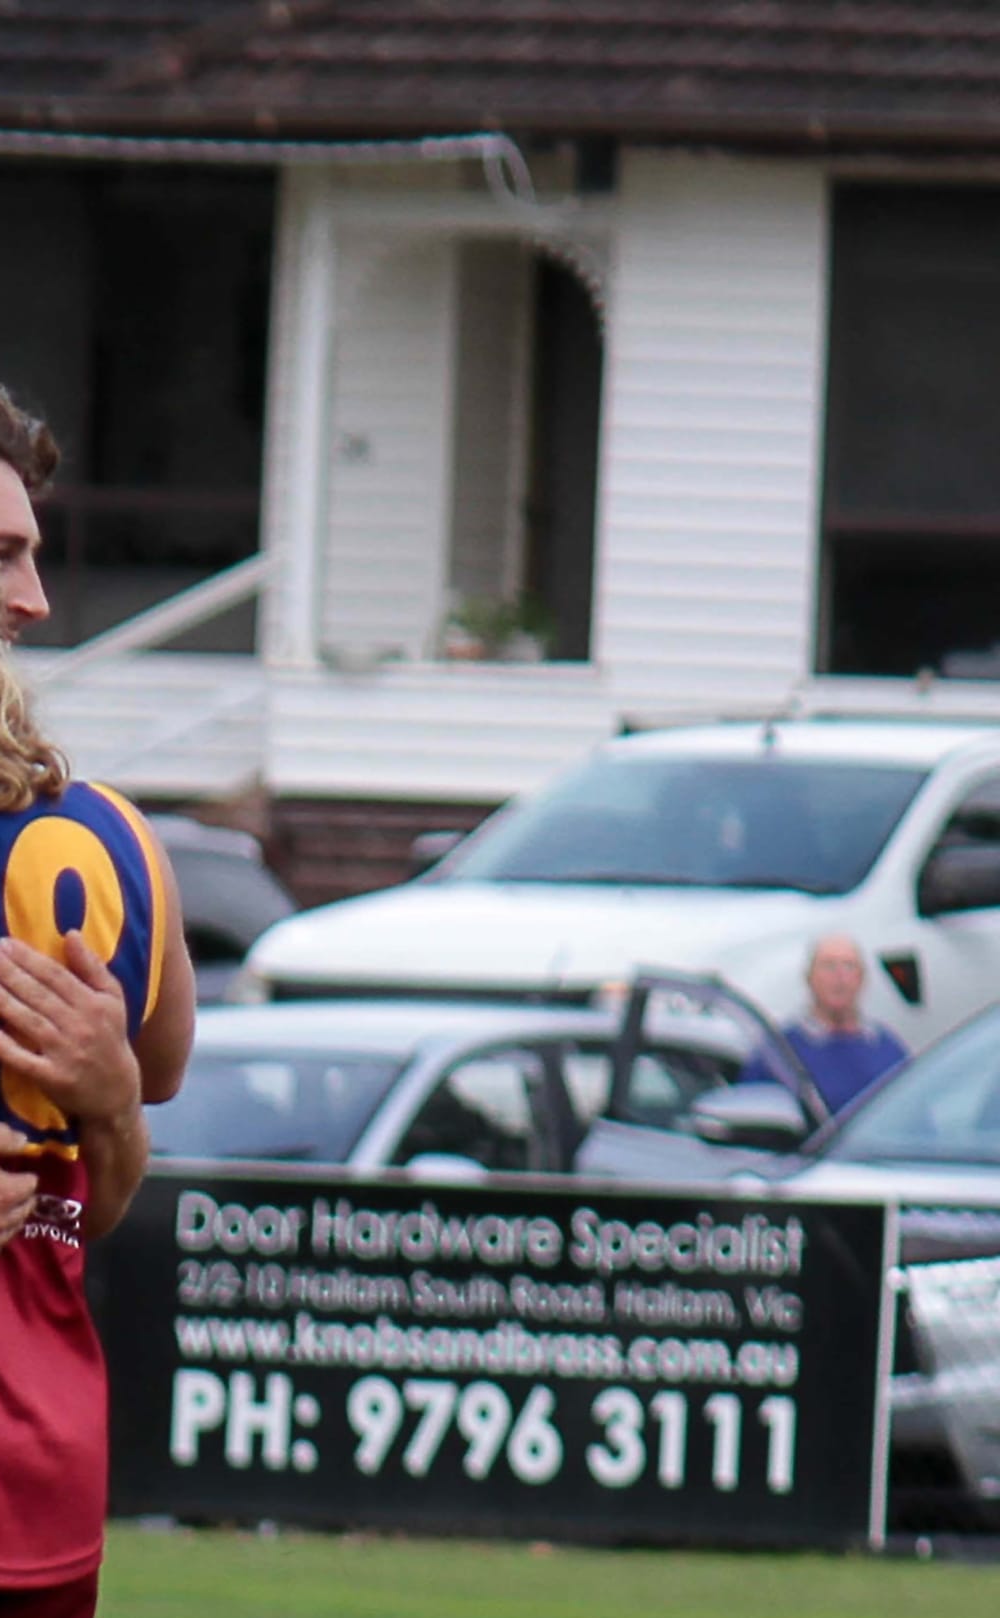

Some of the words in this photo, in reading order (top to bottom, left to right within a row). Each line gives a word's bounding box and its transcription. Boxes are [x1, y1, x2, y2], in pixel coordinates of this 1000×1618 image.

[177, 1190, 305, 1255] Door
[312, 1198, 563, 1268] Hardware
[570, 1206, 803, 1277] Specialist
[411, 1270, 506, 1318] South
[174, 1311, 798, 1386] www.knobsandbrass.com.au
[170, 1367, 320, 1473] PH:
[347, 1373, 563, 1485] 9796
[586, 1386, 796, 1494] 3111
